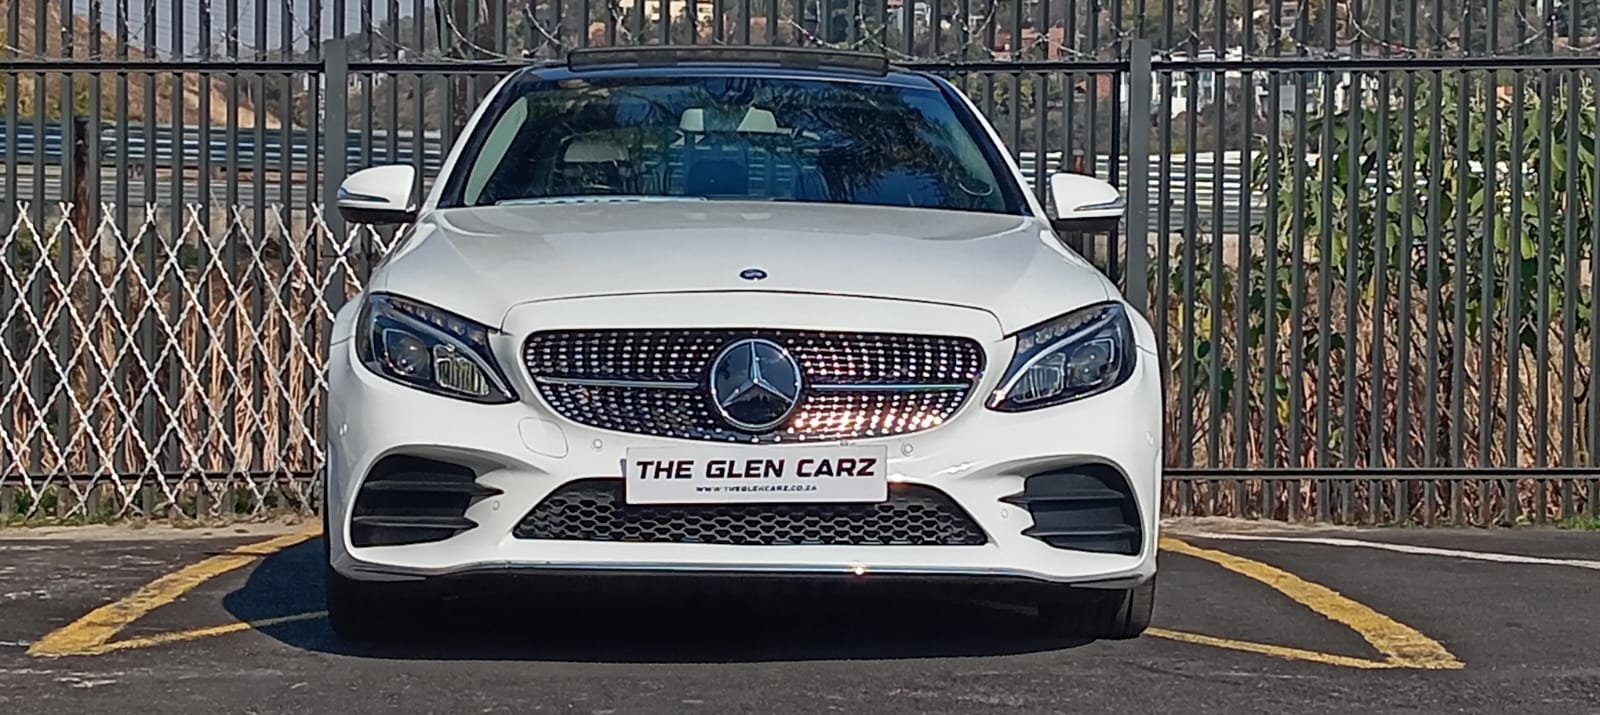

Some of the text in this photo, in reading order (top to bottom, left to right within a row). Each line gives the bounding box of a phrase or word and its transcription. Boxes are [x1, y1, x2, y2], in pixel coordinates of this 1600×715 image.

[636, 458, 876, 479] THE GLEN CARZ
